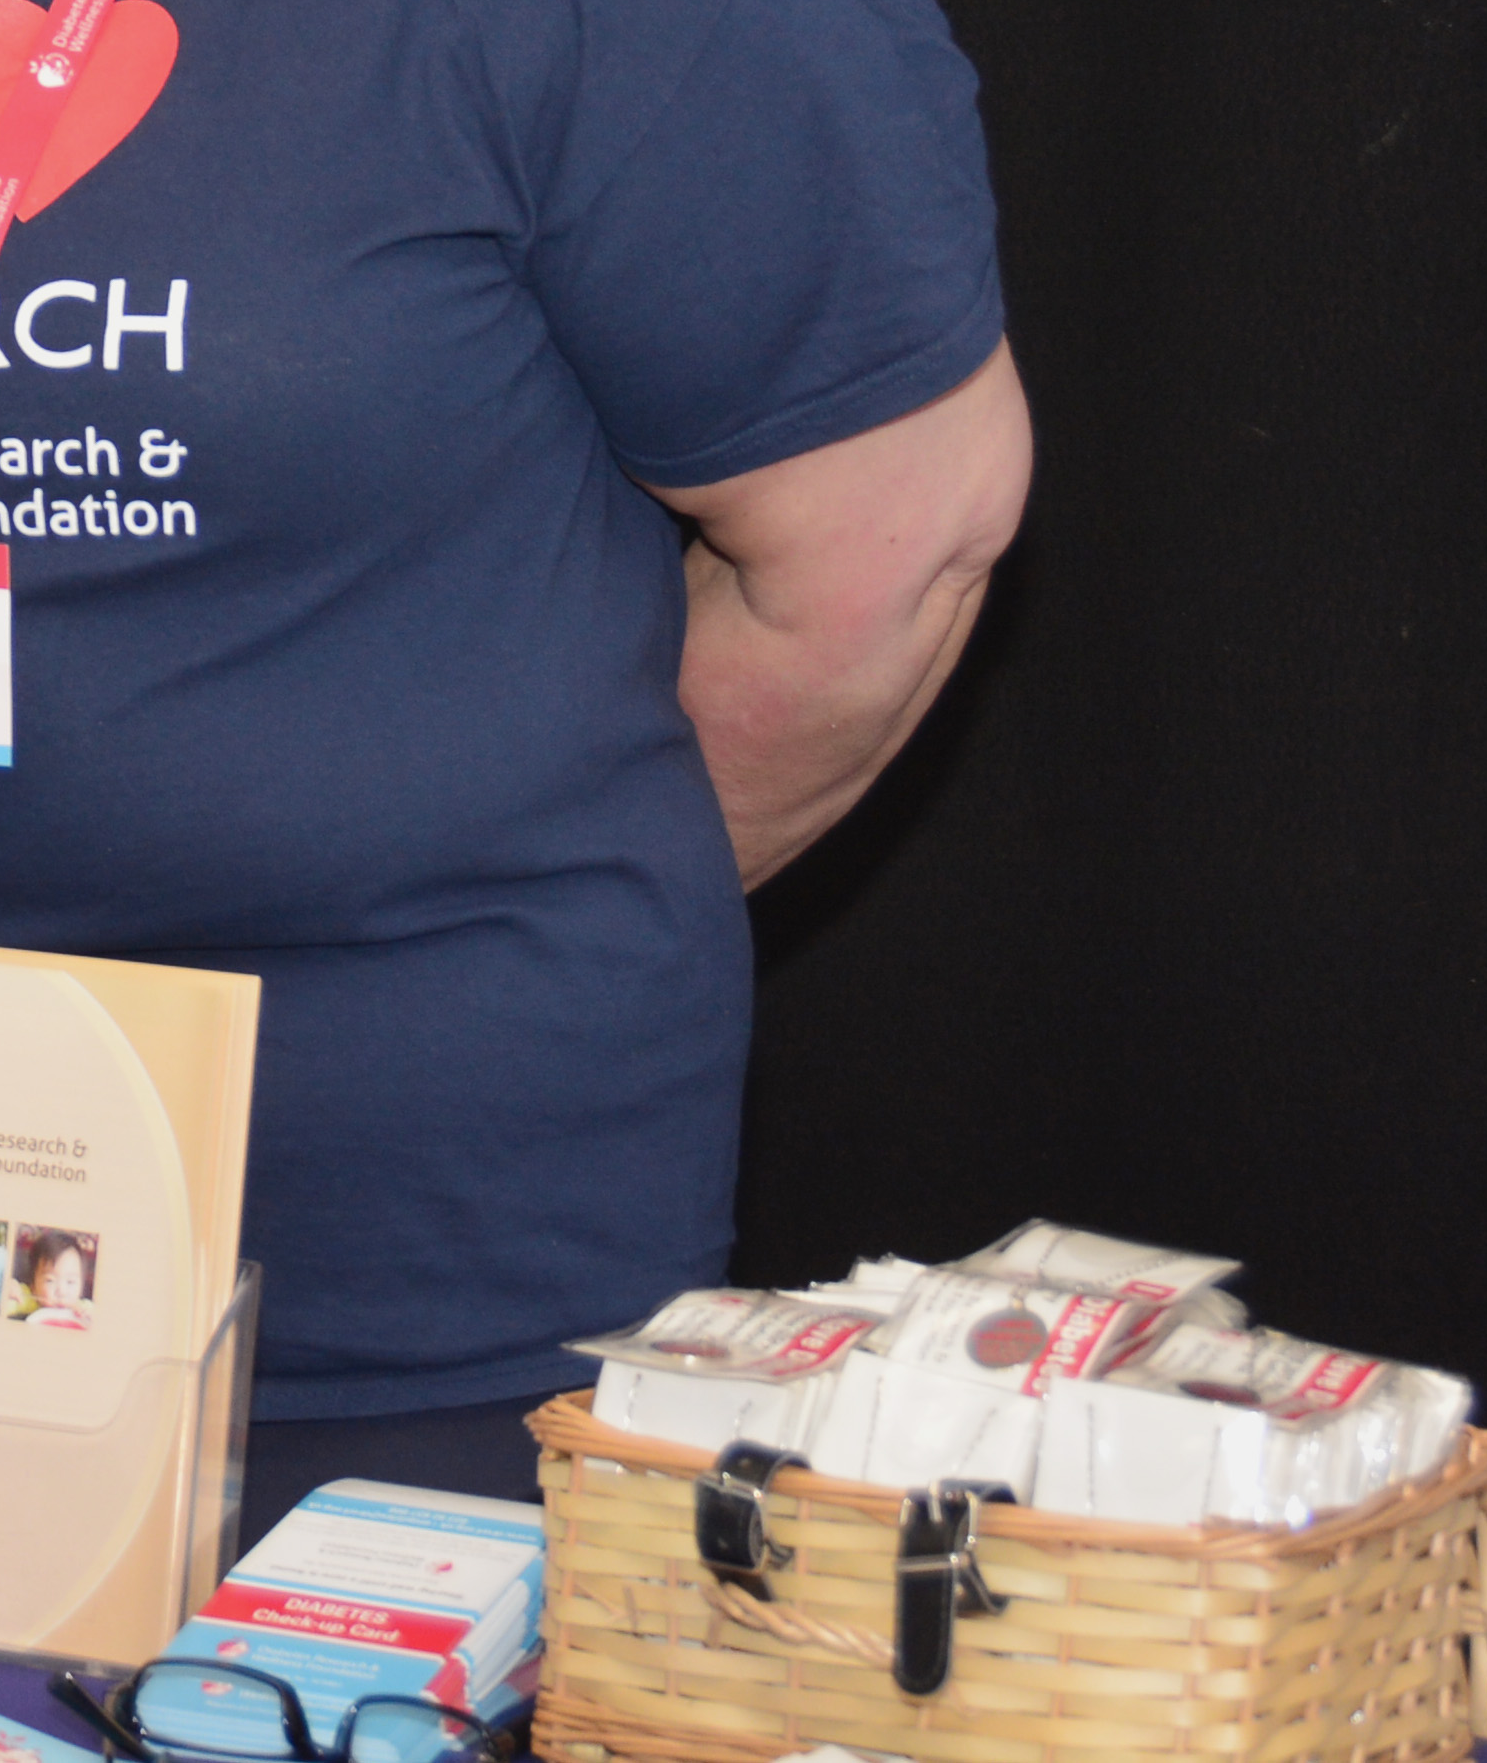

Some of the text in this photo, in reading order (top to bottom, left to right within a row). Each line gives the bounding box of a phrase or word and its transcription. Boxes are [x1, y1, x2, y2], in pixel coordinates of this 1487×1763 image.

[139, 429, 188, 476] &
[72, 1139, 87, 1158] &
[252, 1607, 401, 1643] Check-up Card
[285, 1596, 388, 1626] DIABETES
